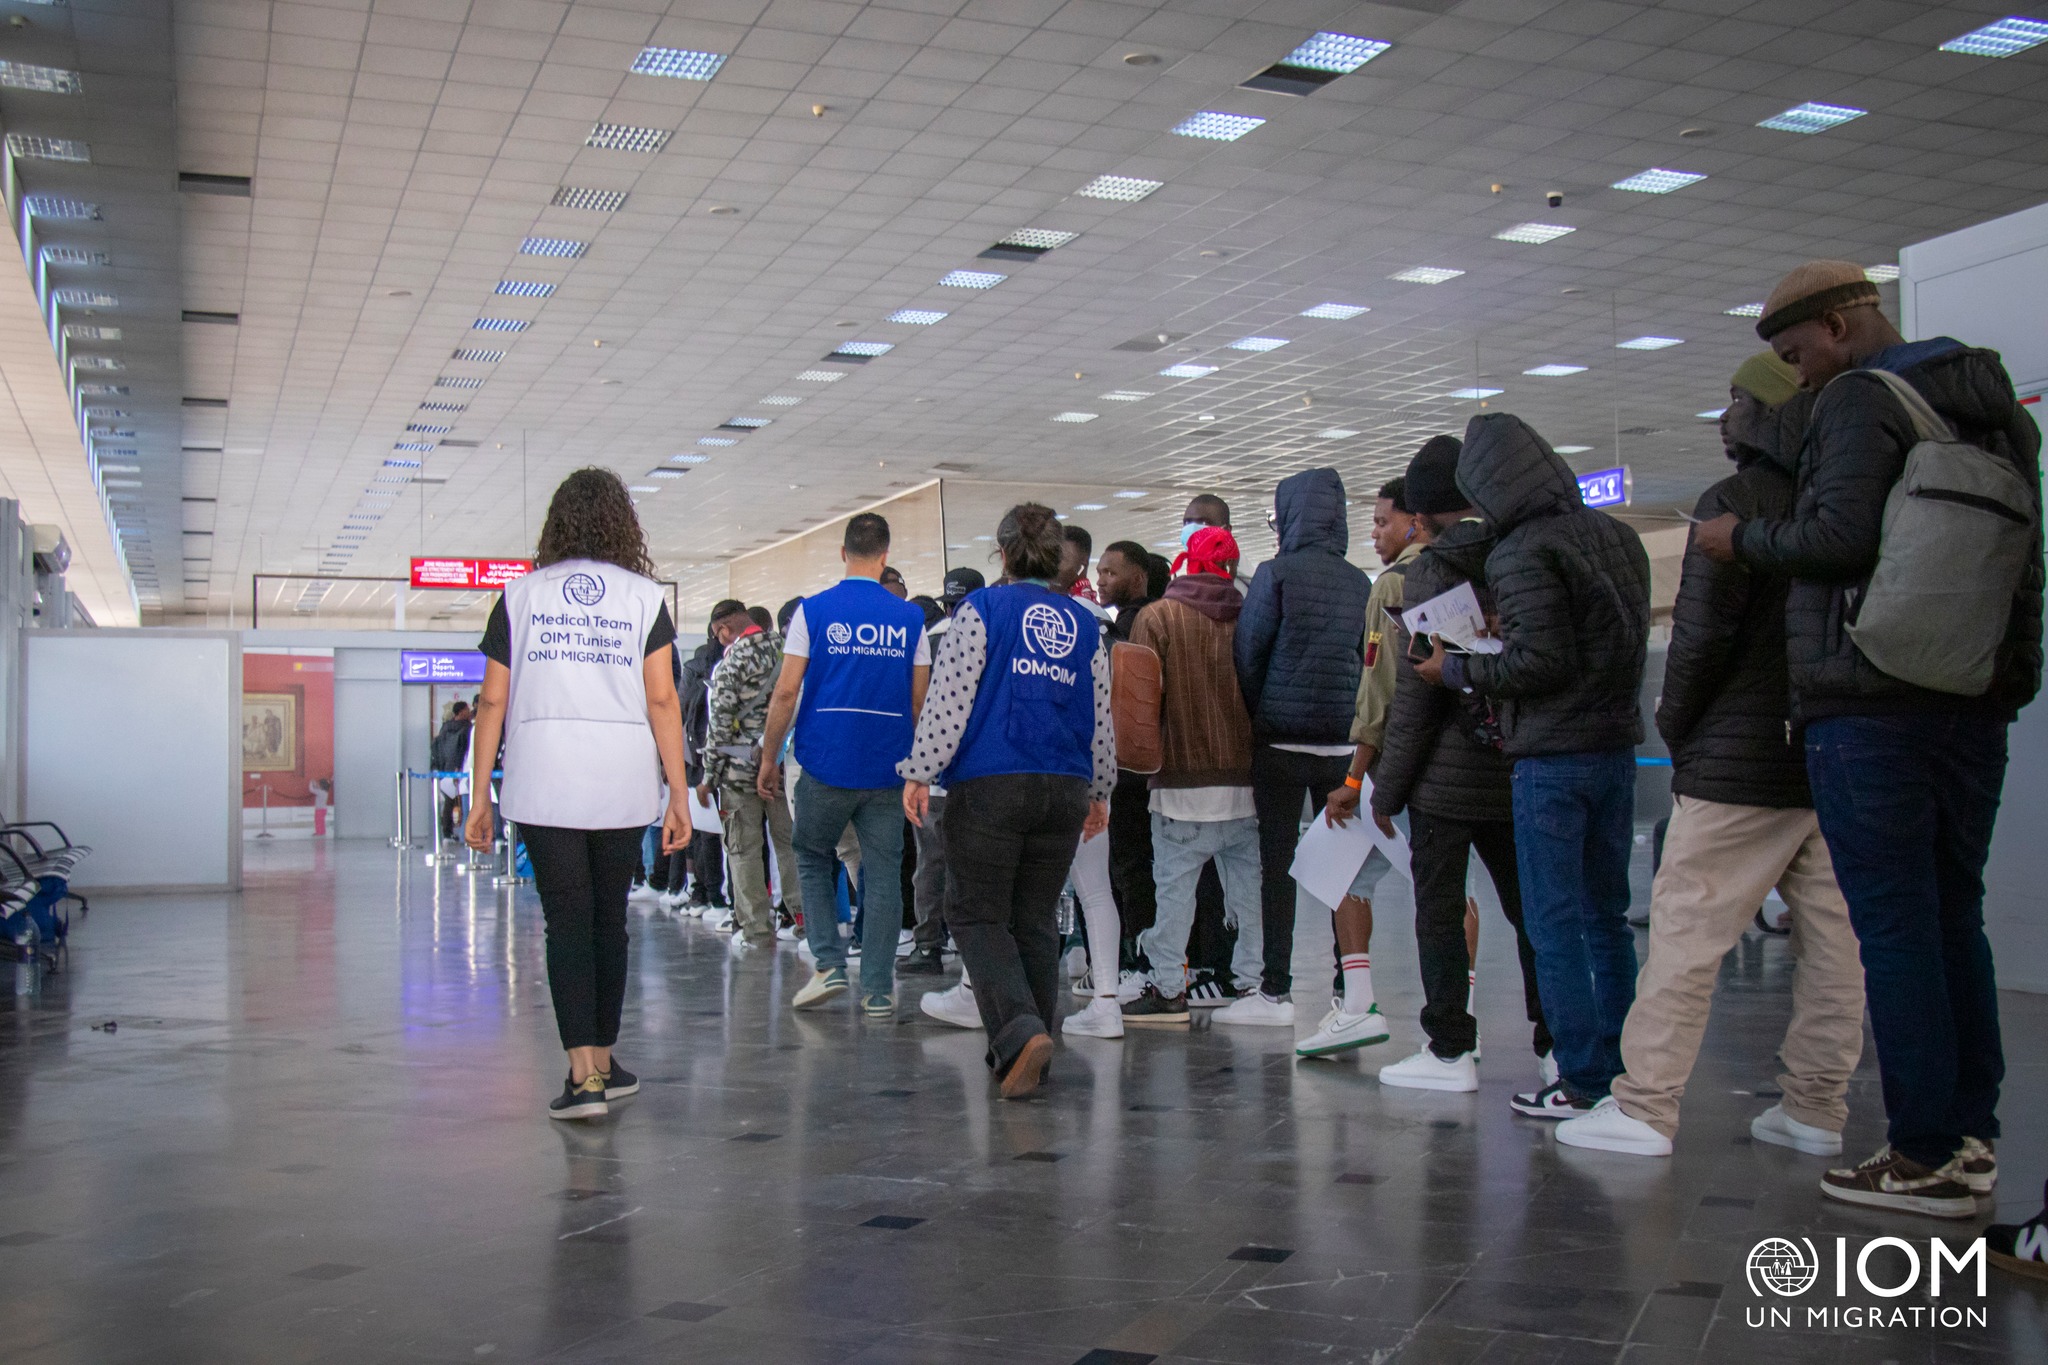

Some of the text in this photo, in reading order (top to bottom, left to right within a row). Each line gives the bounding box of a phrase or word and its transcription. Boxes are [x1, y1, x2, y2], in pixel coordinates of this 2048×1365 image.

[532, 613, 633, 632] Medical Team
[540, 631, 622, 649] OIM Tunisie
[856, 623, 907, 649] OIM
[527, 649, 633, 668] ONU MIGRATION
[827, 645, 905, 658] ONU MIGRATION
